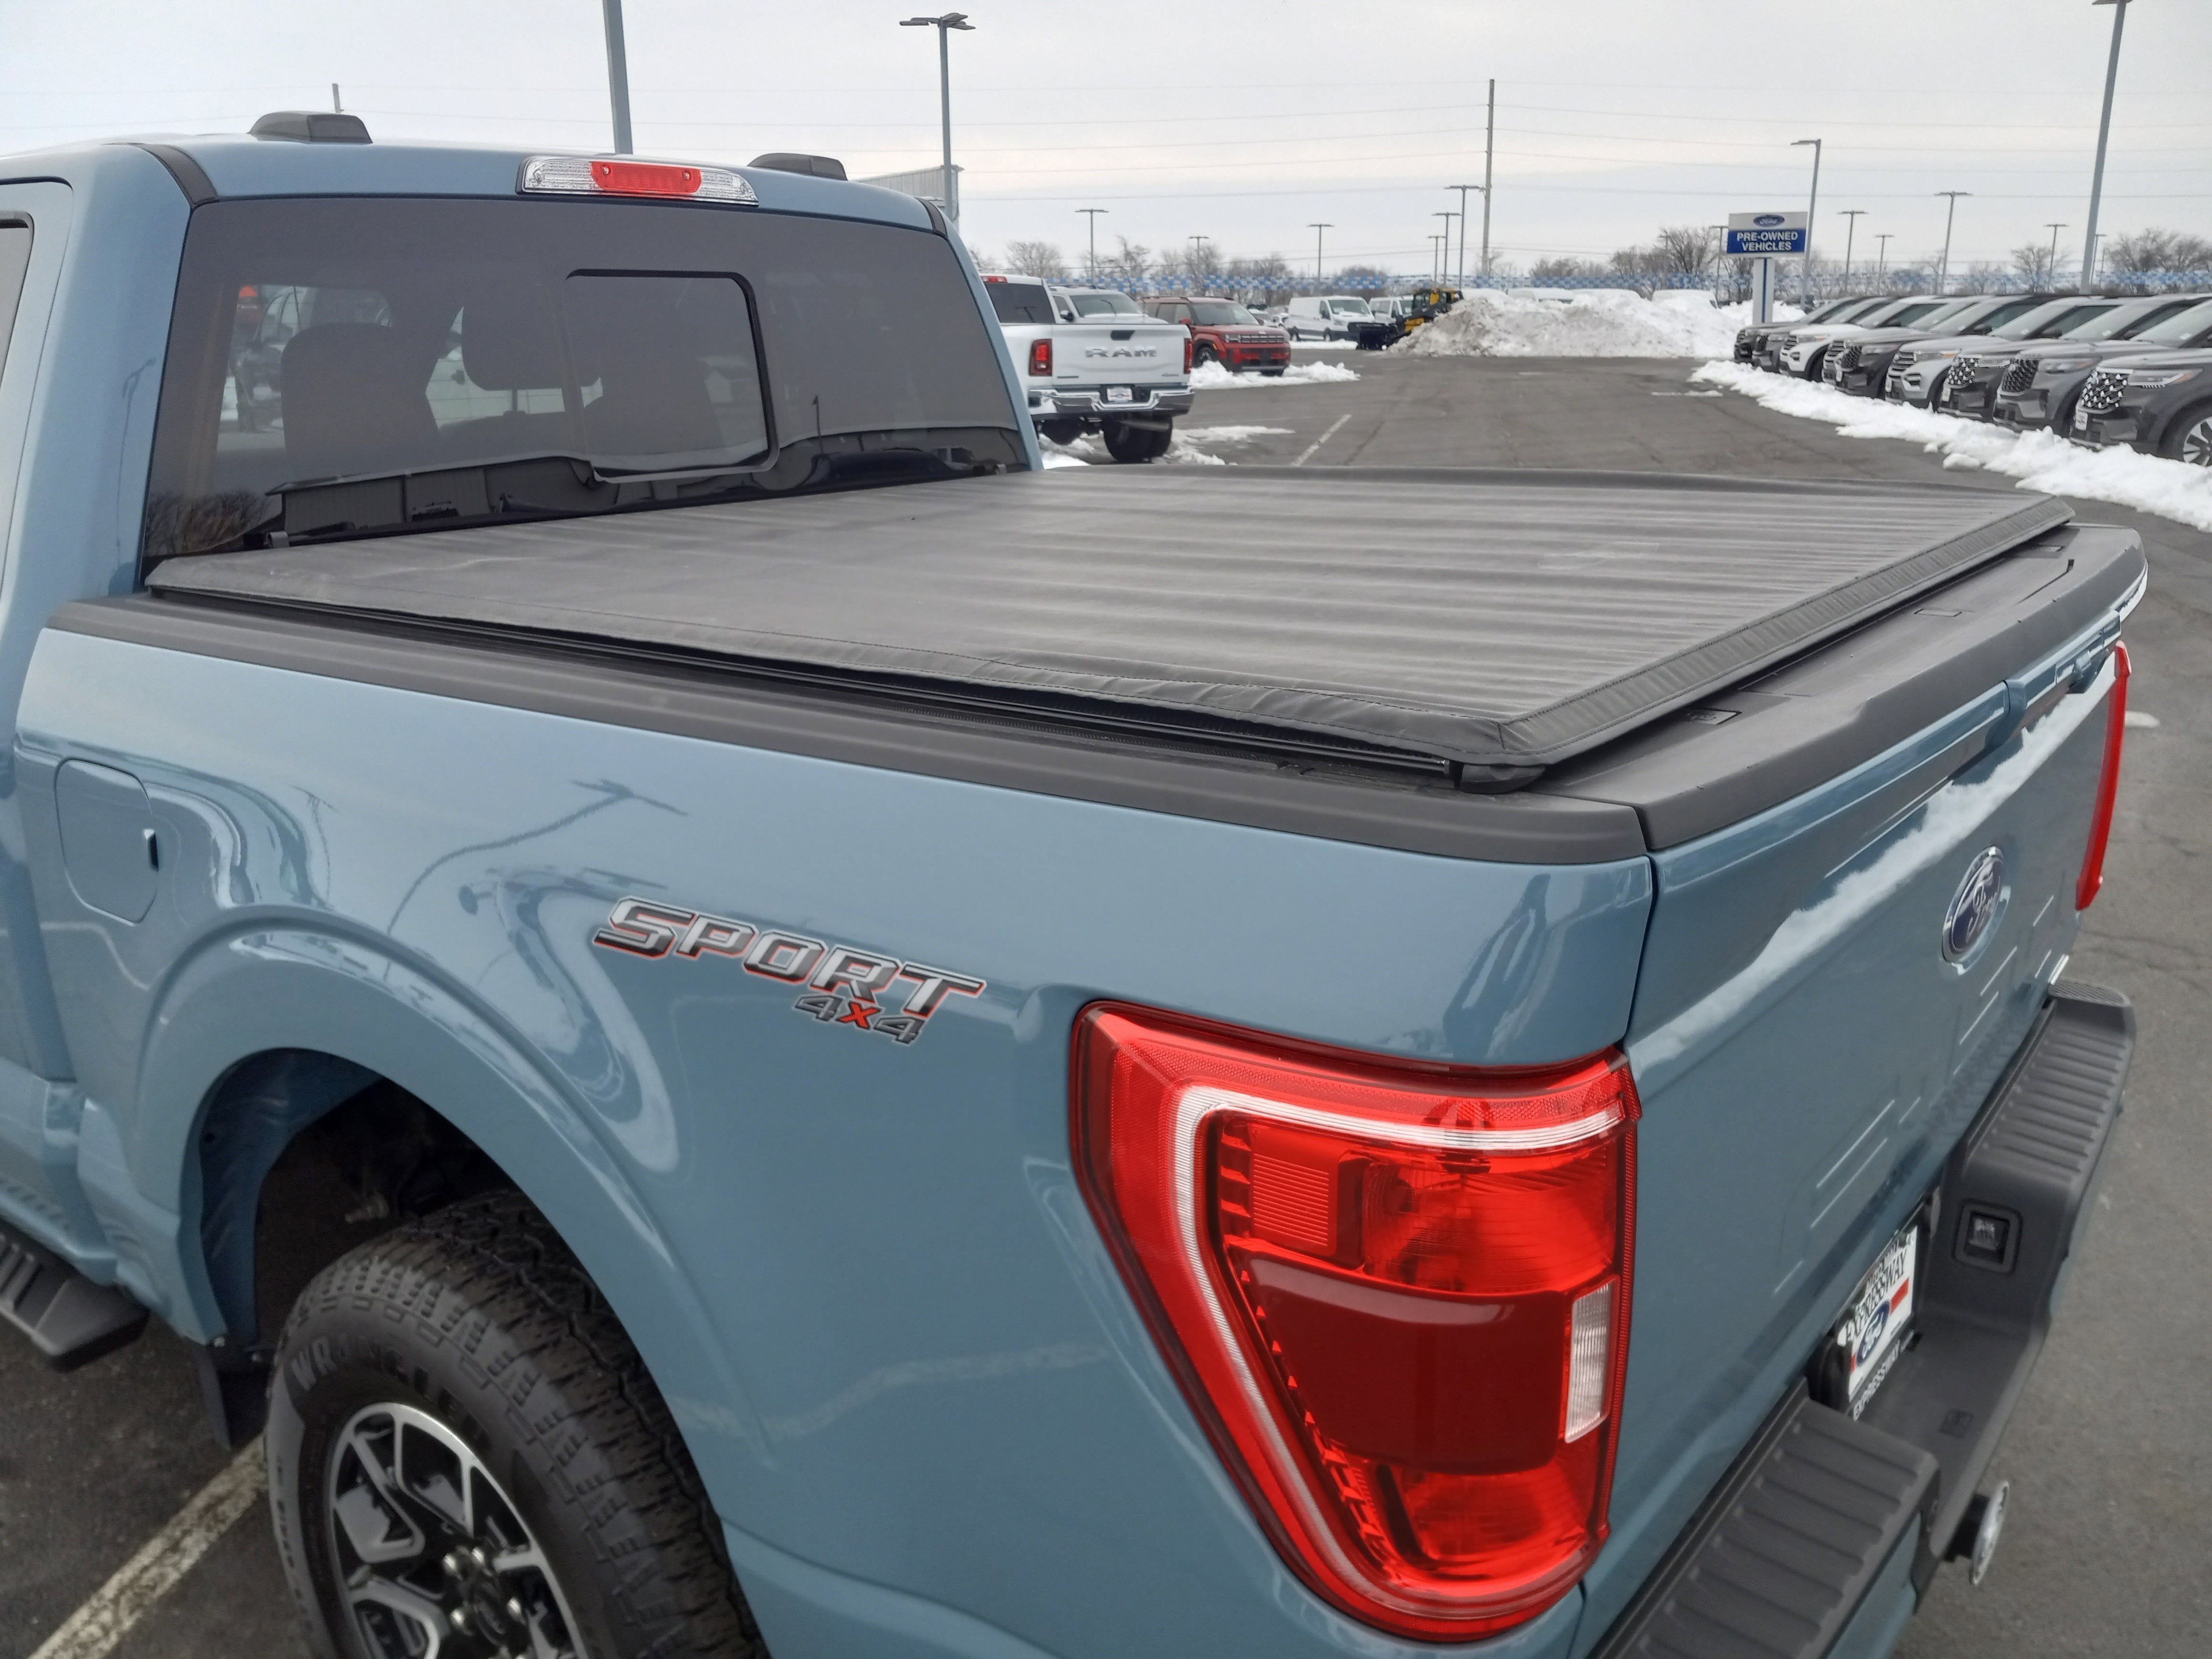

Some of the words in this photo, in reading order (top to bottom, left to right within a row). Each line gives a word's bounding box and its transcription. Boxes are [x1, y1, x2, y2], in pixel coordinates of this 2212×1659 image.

[1736, 231, 1798, 241] PRE-OWNED
[1742, 241, 1792, 252] VEHICLES
[1085, 346, 1157, 358] RAM
[592, 896, 987, 1018] SPORT
[1862, 1311, 1885, 1359] Ford
